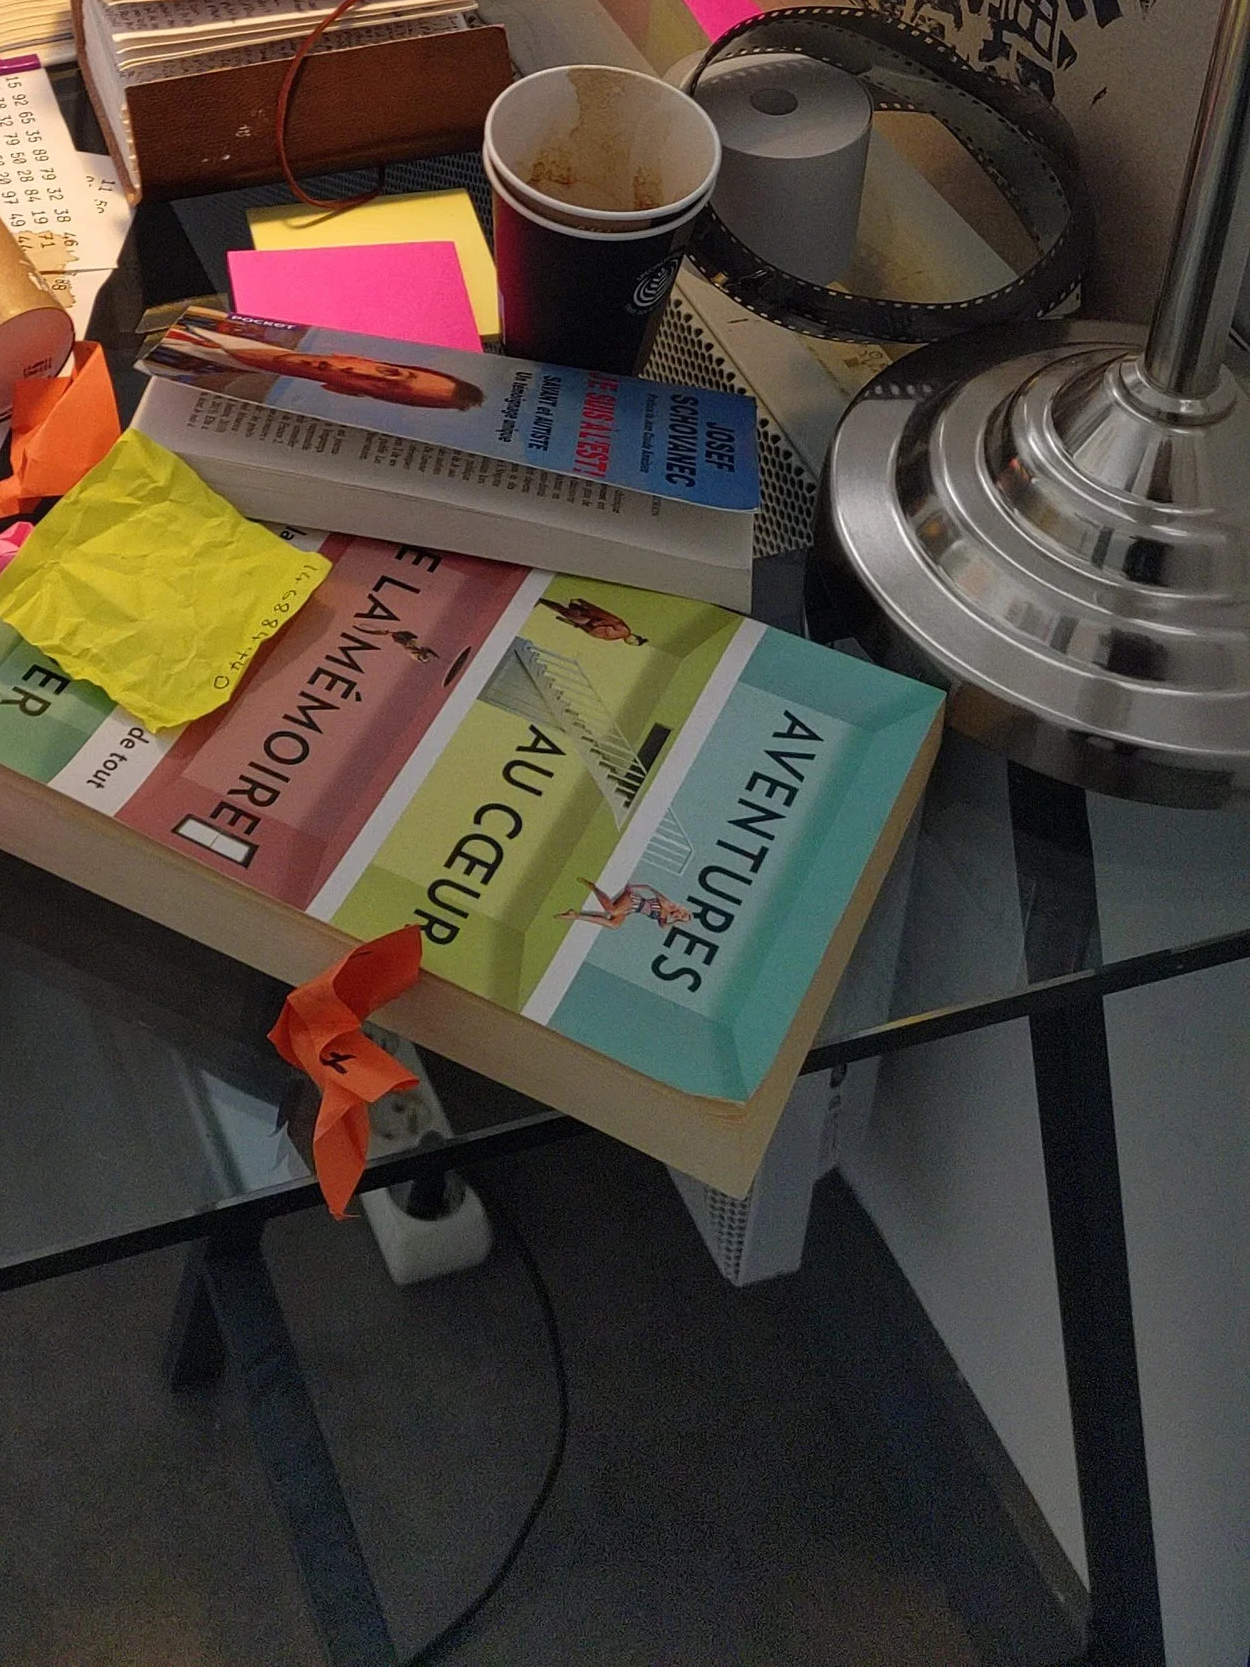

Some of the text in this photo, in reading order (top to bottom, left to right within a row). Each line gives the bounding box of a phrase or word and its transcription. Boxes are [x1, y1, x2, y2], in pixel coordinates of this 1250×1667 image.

[3, 132, 21, 146] 79
[5, 76, 79, 247] 15 92 65 35 89 79 32 38 46
[10, 151, 28, 165] 50
[16, 169, 35, 183] 28
[23, 188, 42, 203] 84
[30, 210, 49, 225] 19
[38, 232, 56, 249] 71
[527, 375, 562, 452] SAVANT et AUTISTE
[581, 392, 617, 422] SUIS
[667, 392, 701, 489] SCHOVANEC
[704, 421, 736, 473] JOSEF
[395, 545, 442, 573] E
[355, 575, 421, 621] LA
[86, 726, 150, 789] de tout
[211, 632, 382, 837] MÉMOIRE
[413, 724, 568, 948] AU CŒUR
[649, 709, 827, 996] AVENTURES
